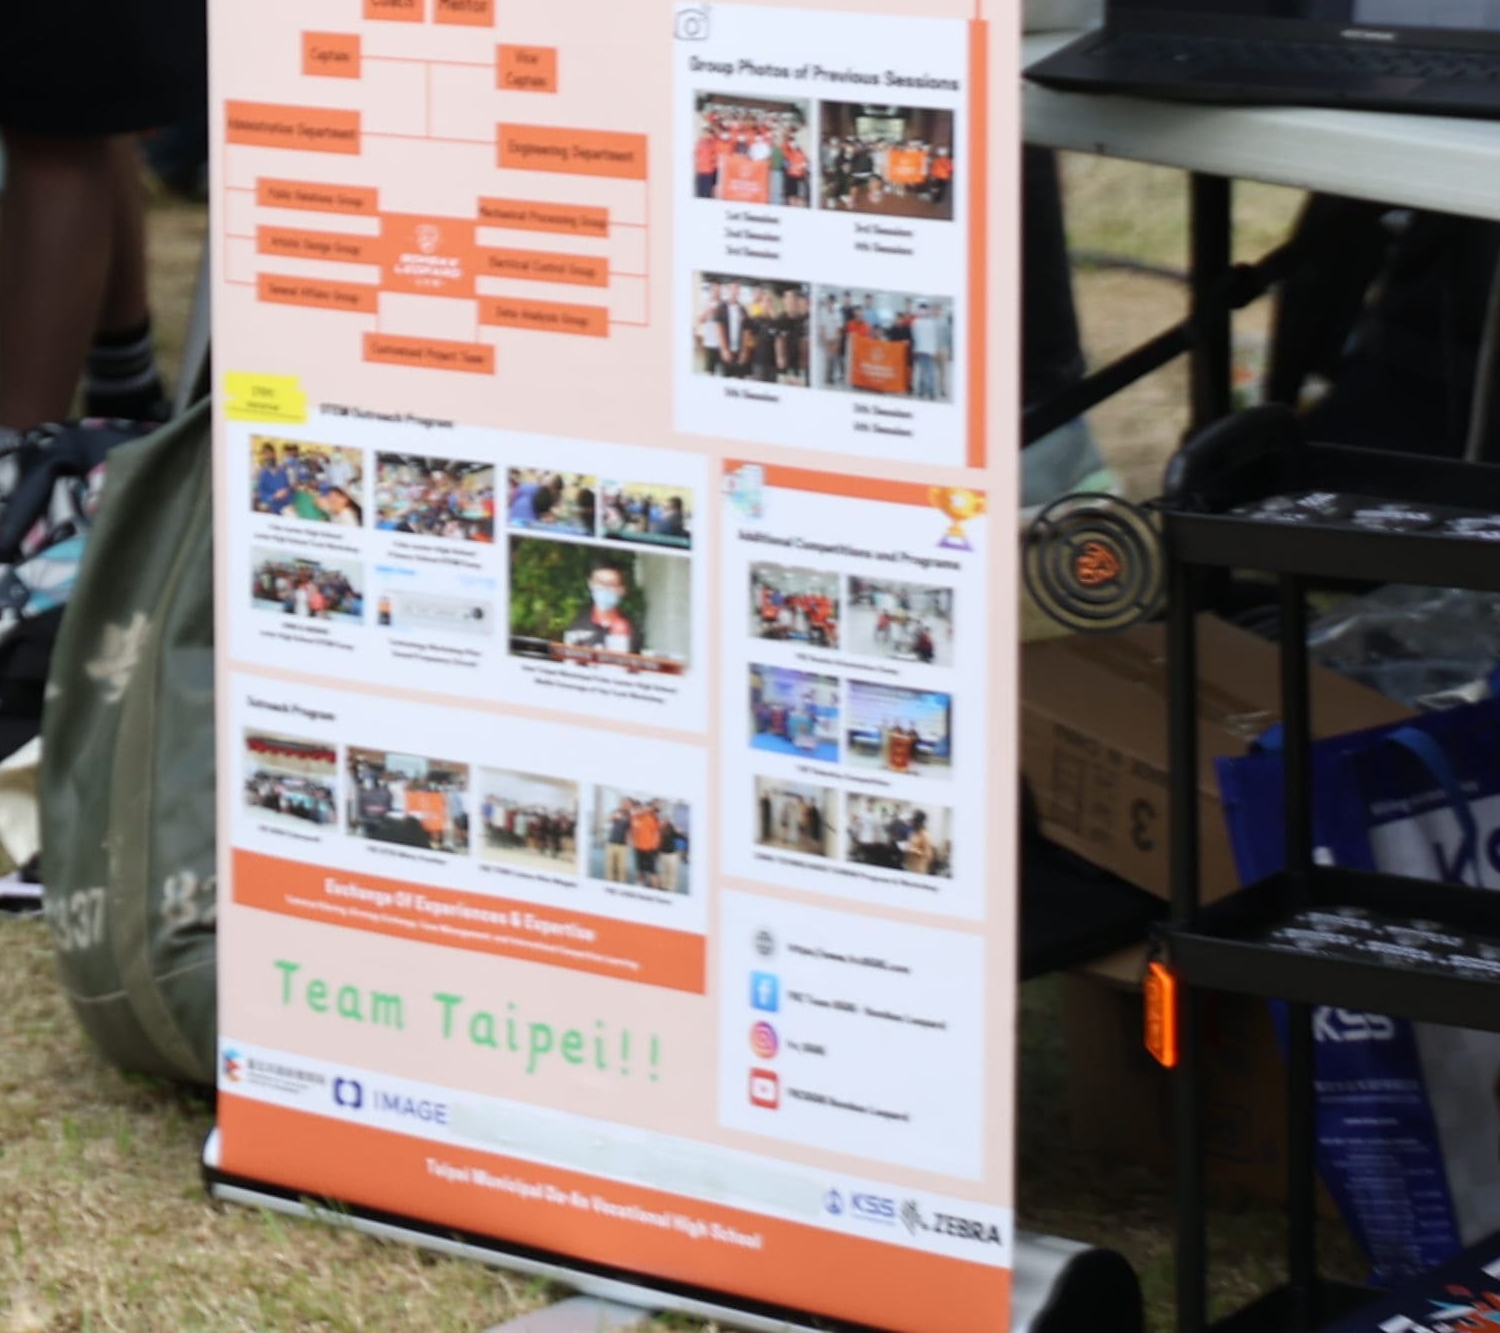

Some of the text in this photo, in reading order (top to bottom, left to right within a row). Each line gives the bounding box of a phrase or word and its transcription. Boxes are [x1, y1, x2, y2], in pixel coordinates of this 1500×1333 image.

[690, 55, 733, 76] Group
[814, 64, 879, 84] Previous
[885, 69, 958, 90] Sessions
[325, 877, 391, 908] Exchange
[274, 959, 661, 1082] Team Taipei!!
[373, 1091, 448, 1125] IMAGE
[850, 1191, 897, 1218] KSS
[675, 1213, 706, 1239] High
[712, 1221, 762, 1250] School
[932, 1213, 1002, 1246] ZEBRA
